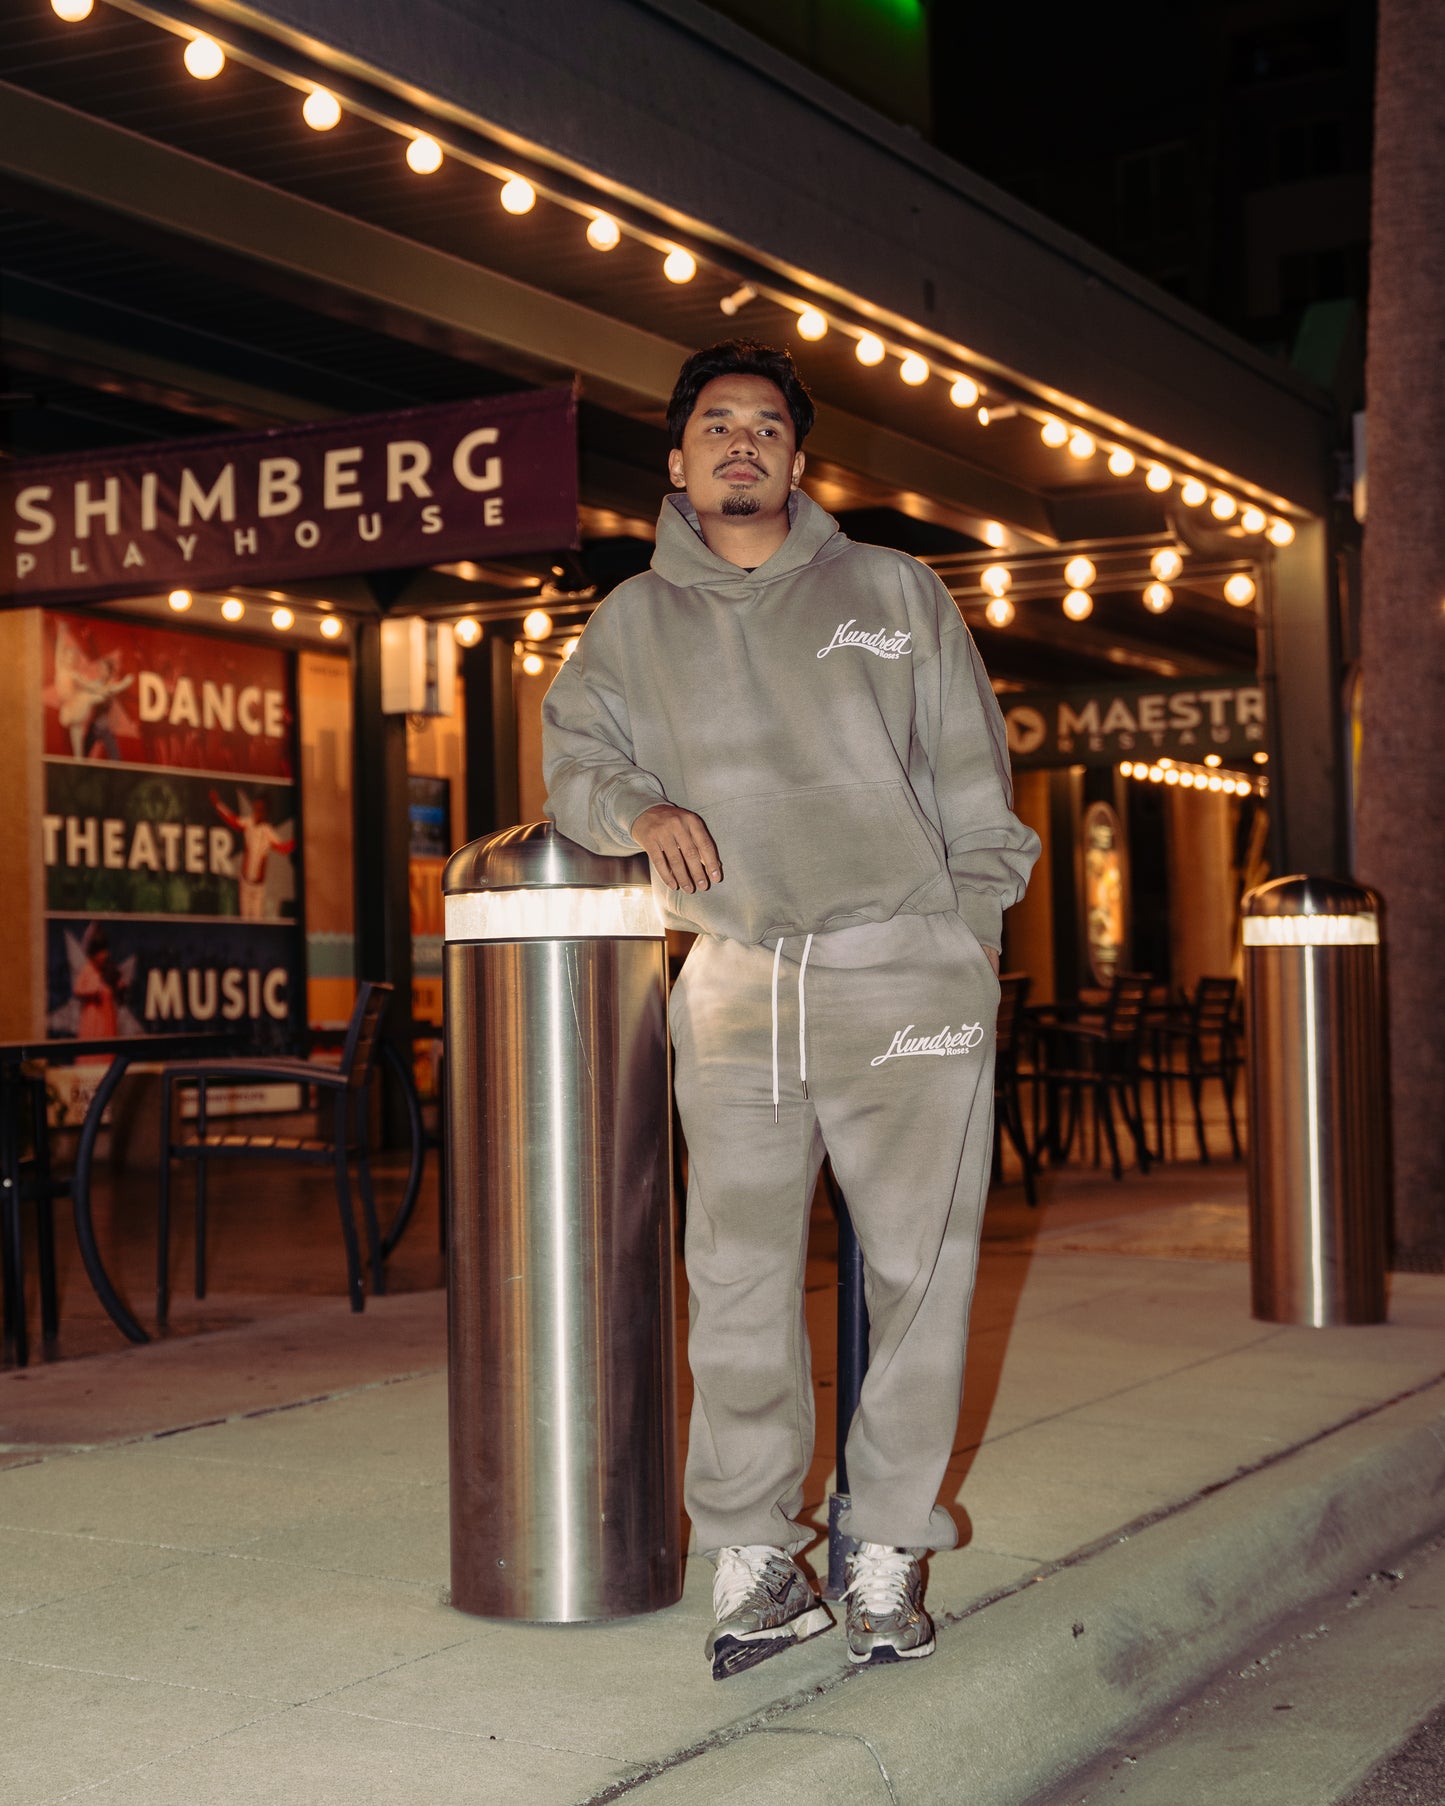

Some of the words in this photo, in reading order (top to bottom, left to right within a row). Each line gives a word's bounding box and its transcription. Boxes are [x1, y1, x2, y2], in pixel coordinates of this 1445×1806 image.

[14, 426, 503, 546] SHIMBERG
[15, 497, 505, 579] PLAYHOUSE
[816, 619, 913, 659] Hundred
[879, 650, 900, 660] Roses
[137, 671, 285, 738] DANCE
[1056, 687, 1266, 735] MAESTR
[43, 814, 240, 878] THEATER
[145, 967, 289, 1021] MUSIC
[870, 1021, 984, 1067] Hundred
[946, 1047, 970, 1056] Roses
